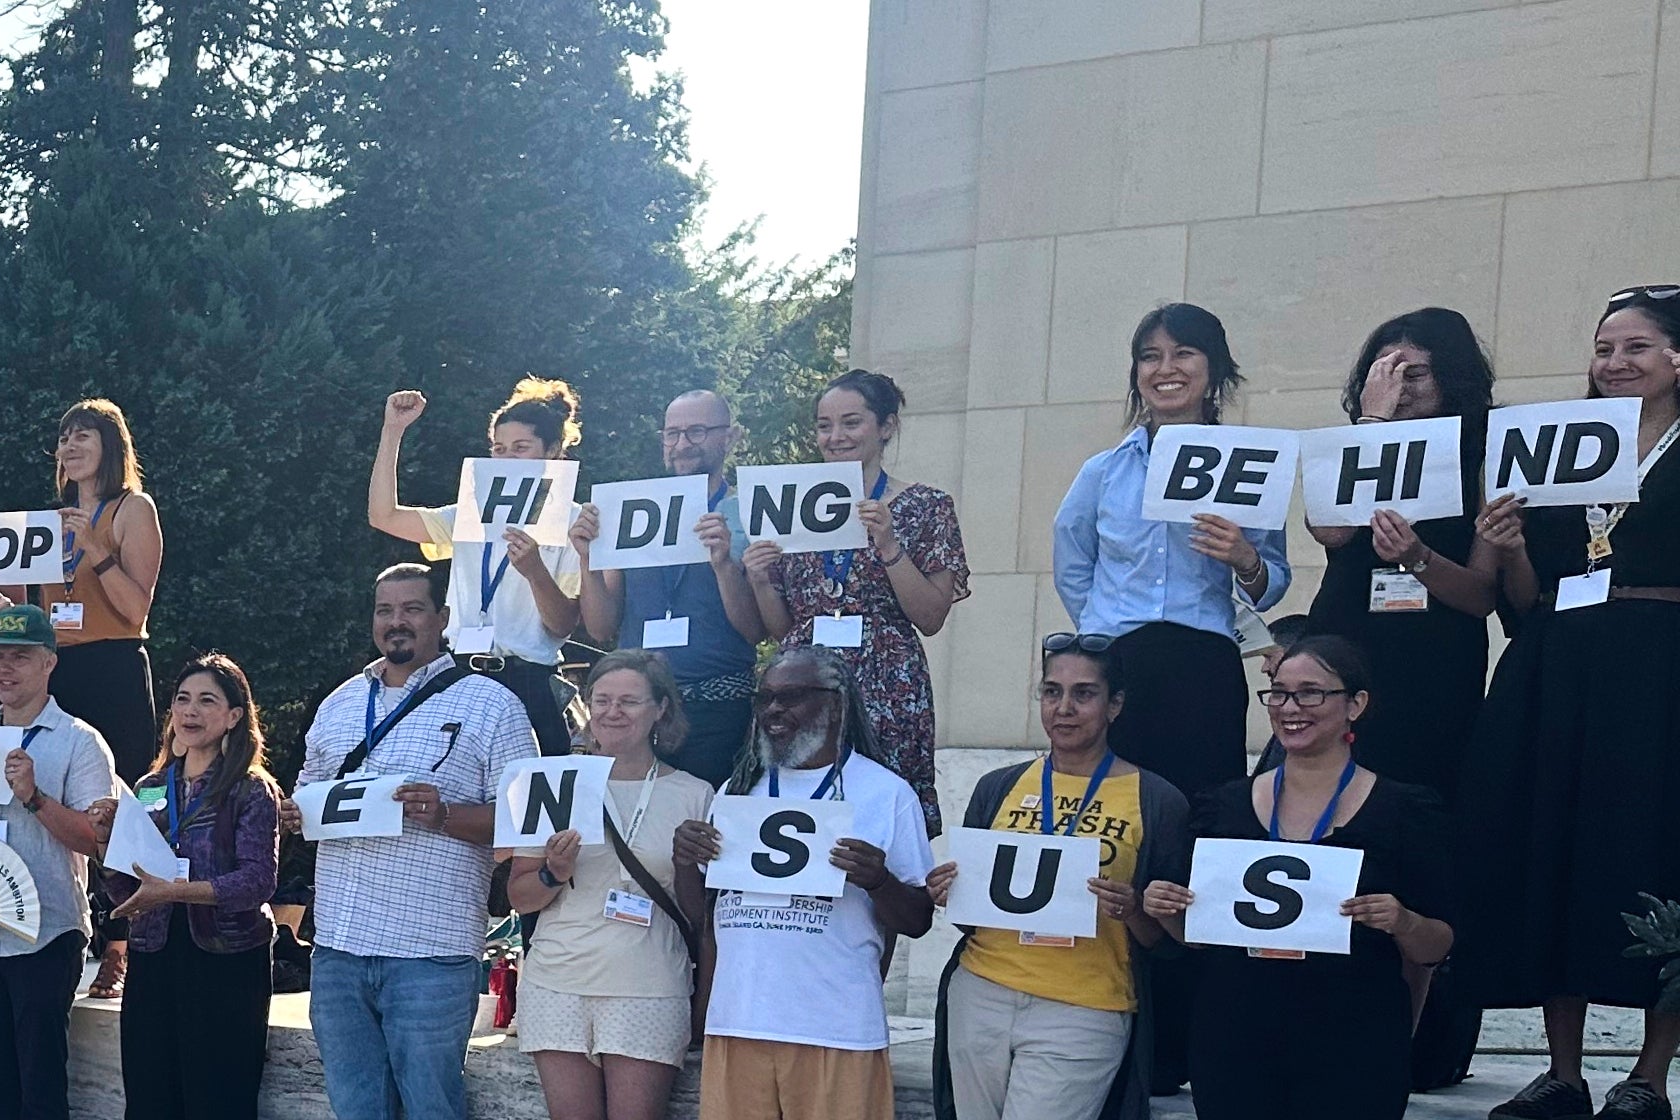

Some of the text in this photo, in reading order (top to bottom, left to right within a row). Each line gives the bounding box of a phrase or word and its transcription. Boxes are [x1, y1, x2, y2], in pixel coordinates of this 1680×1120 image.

[1164, 445, 1278, 506] BE
[1336, 440, 1426, 505] HI
[1496, 422, 1619, 489] ND
[481, 477, 552, 524] HI
[616, 496, 683, 549] DI
[750, 482, 851, 535] NG
[321, 777, 378, 825] E
[521, 770, 577, 834] N
[1007, 810, 1130, 841] TRASH
[1087, 800, 1103, 814] A
[751, 811, 815, 878] S
[6, 876, 25, 921] AMBITION
[990, 844, 1062, 914] U
[1234, 855, 1310, 930] S
[772, 910, 828, 927] INSTITUTE
